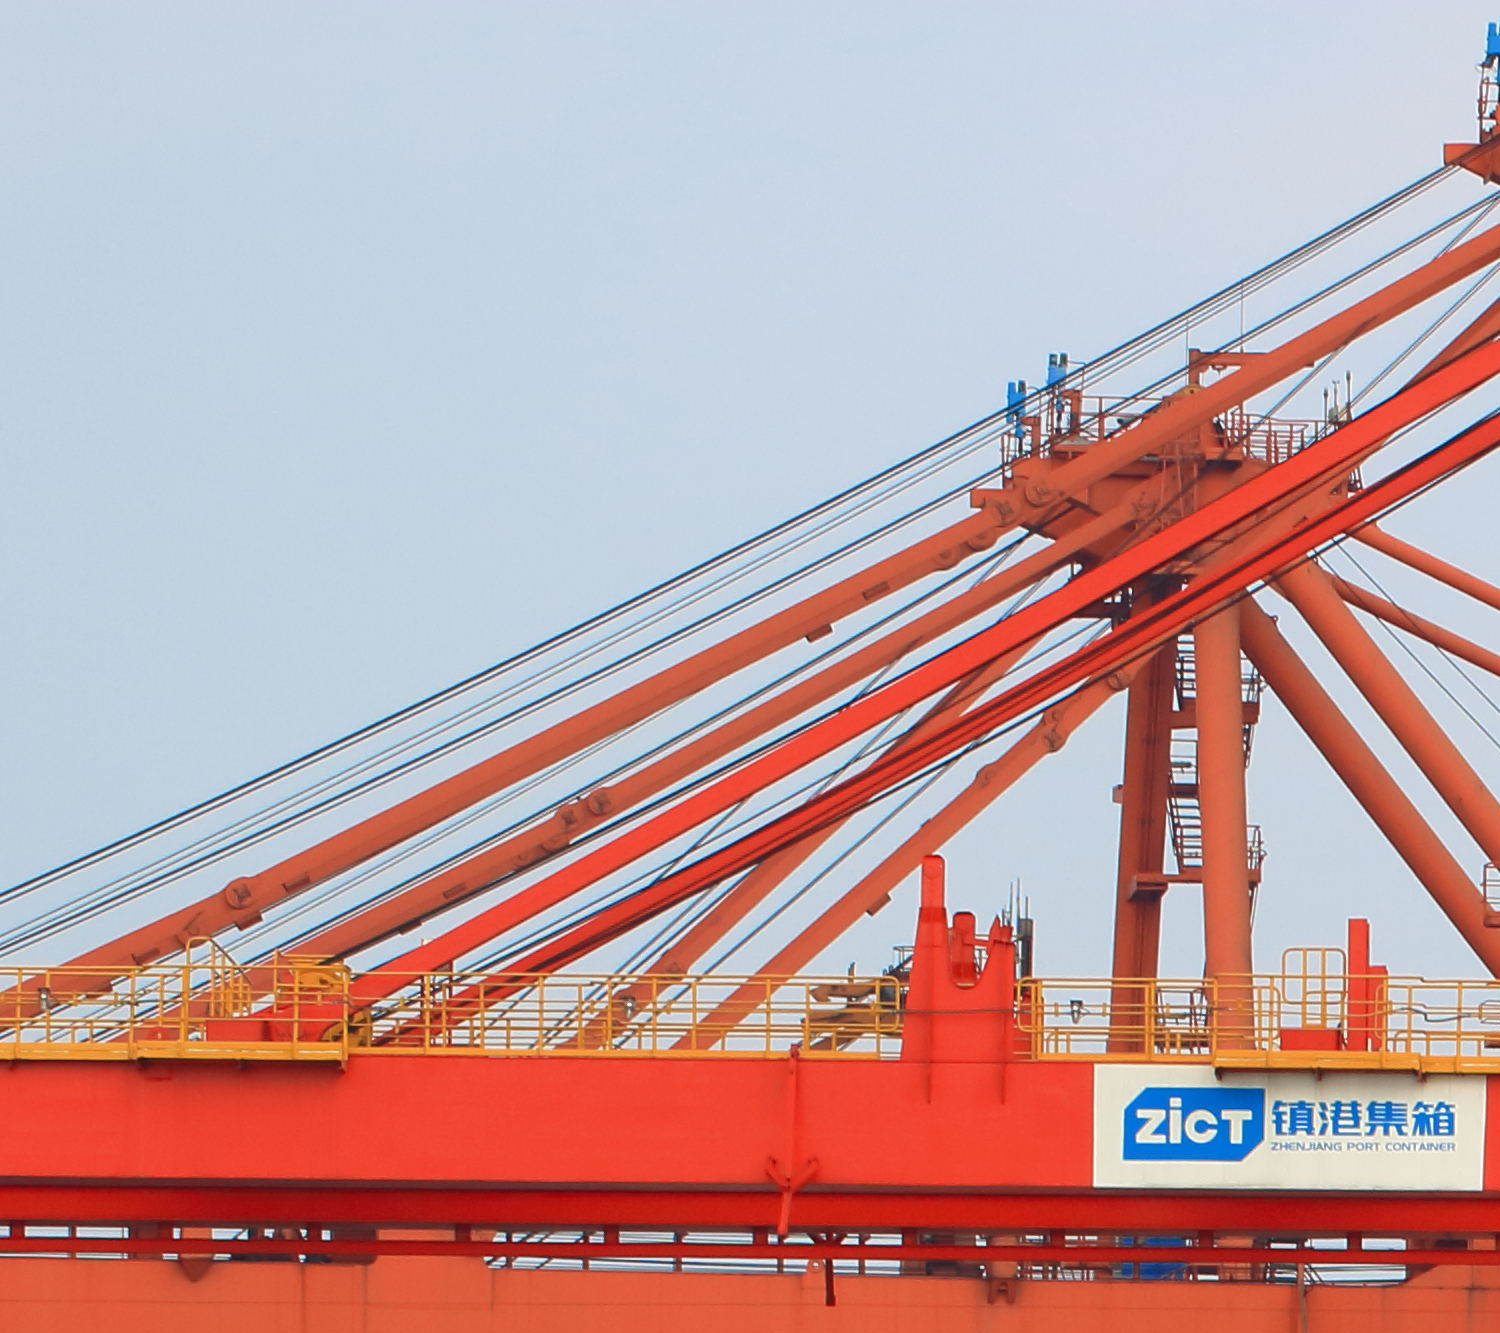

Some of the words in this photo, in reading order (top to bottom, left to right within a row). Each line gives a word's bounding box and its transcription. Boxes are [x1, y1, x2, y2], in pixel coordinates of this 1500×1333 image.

[1272, 1100, 1456, 1137] 镇港集箱
[1271, 1142, 1343, 1152] ZHENJIANG
[1347, 1142, 1380, 1152] PORT
[1385, 1142, 1456, 1152] CONTAINER
